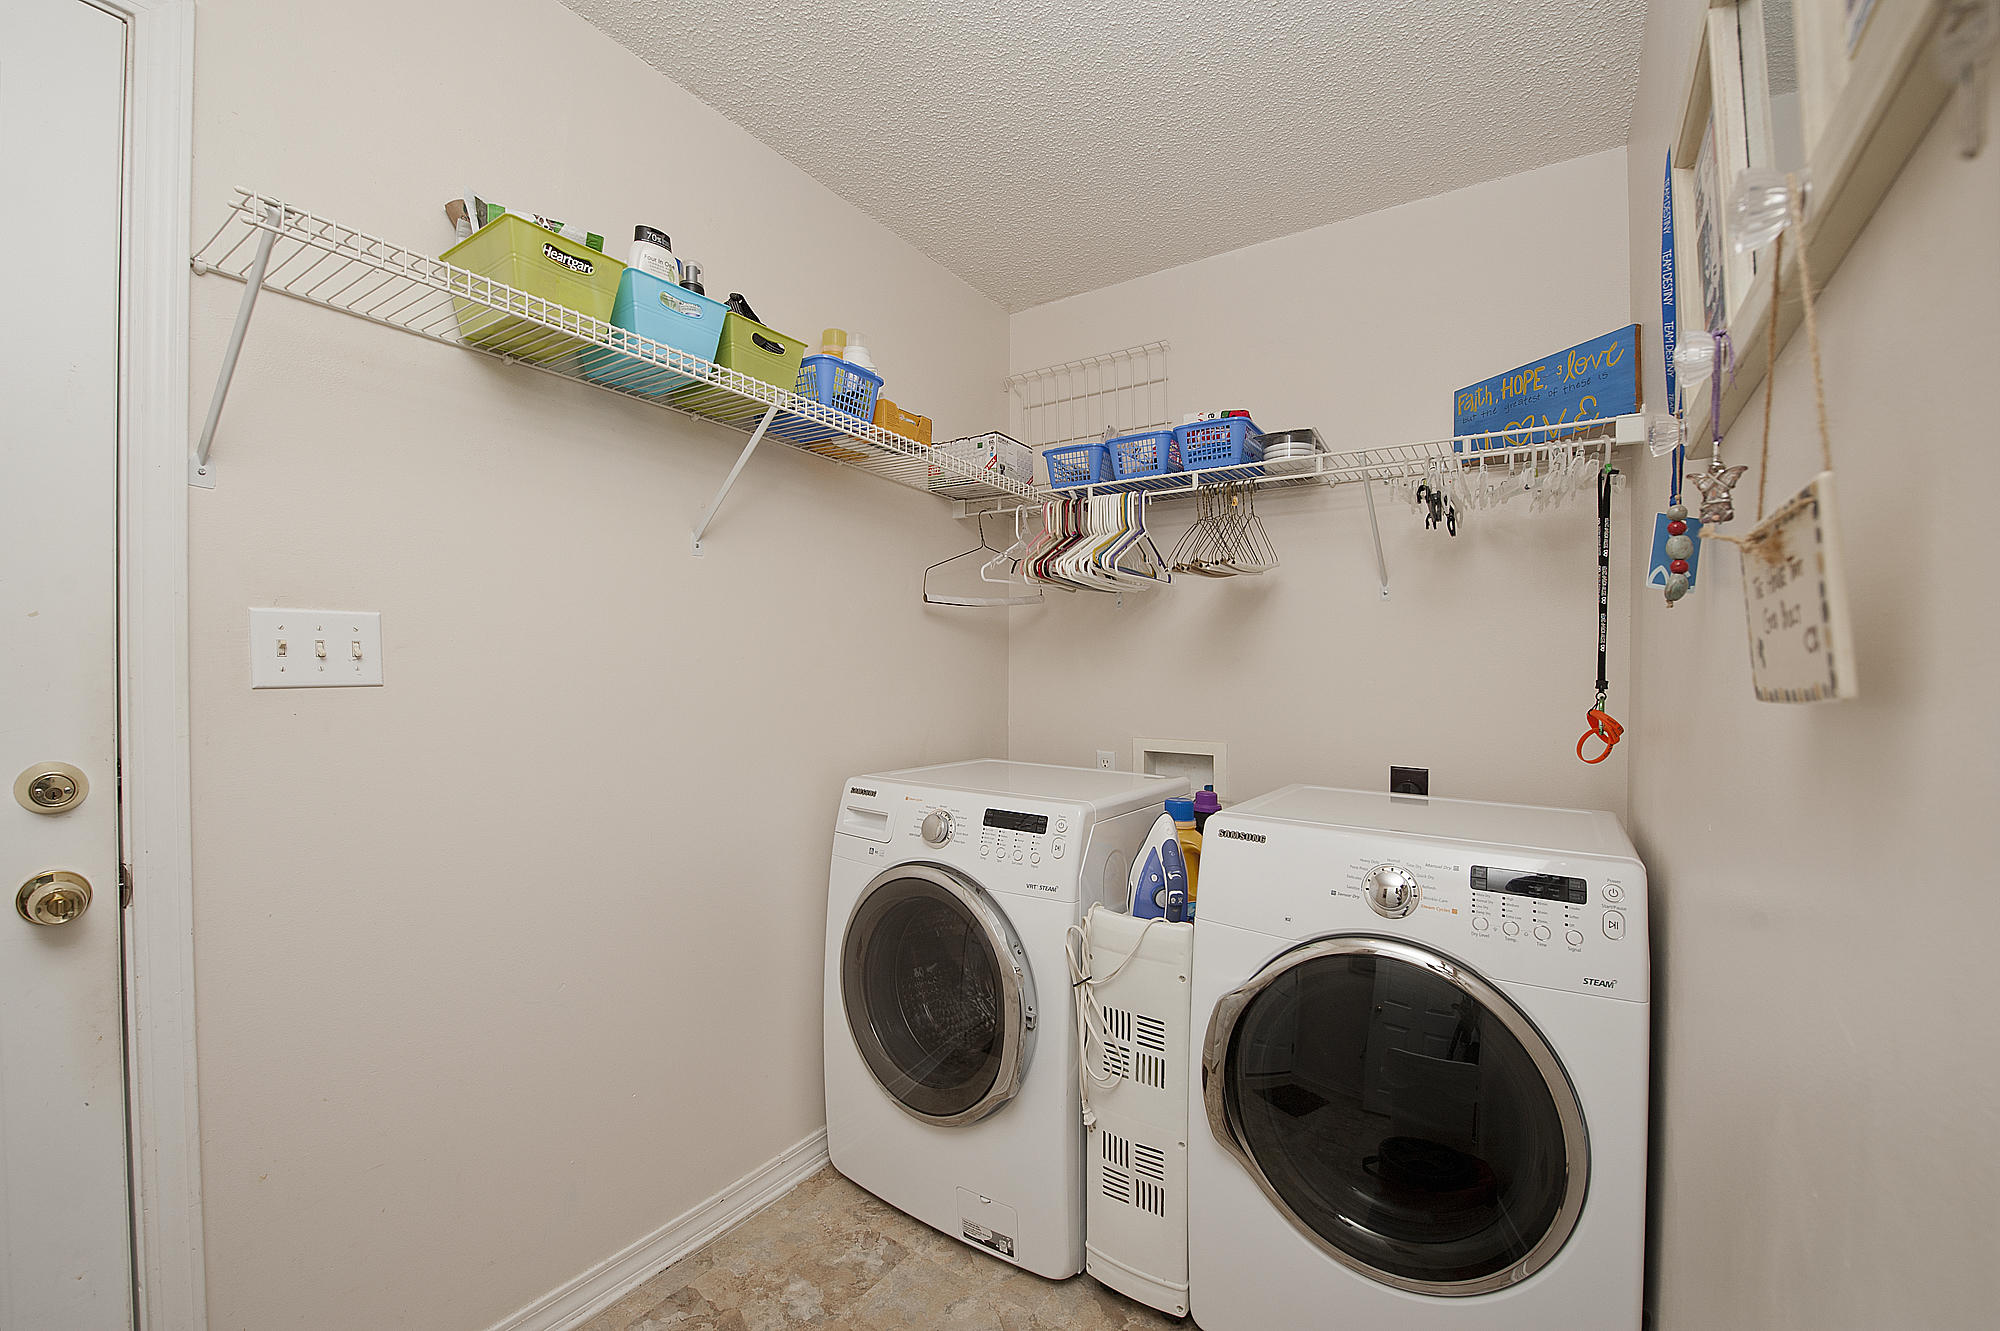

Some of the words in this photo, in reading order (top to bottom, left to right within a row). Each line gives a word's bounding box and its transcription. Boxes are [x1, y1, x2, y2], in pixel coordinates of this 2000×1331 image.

[1662, 248, 1673, 272] TEAM
[1662, 272, 1674, 305] DESTINY
[1664, 320, 1674, 344] TEAM
[1563, 341, 1625, 383] love
[1665, 344, 1675, 378] DESTINY
[1481, 407, 1497, 418] the
[1504, 394, 1541, 413] greatest
[1548, 387, 1558, 398] of
[1563, 378, 1592, 394] these
[1218, 829, 1267, 843] SAMSUNG
[1583, 977, 1614, 989] STEAM
